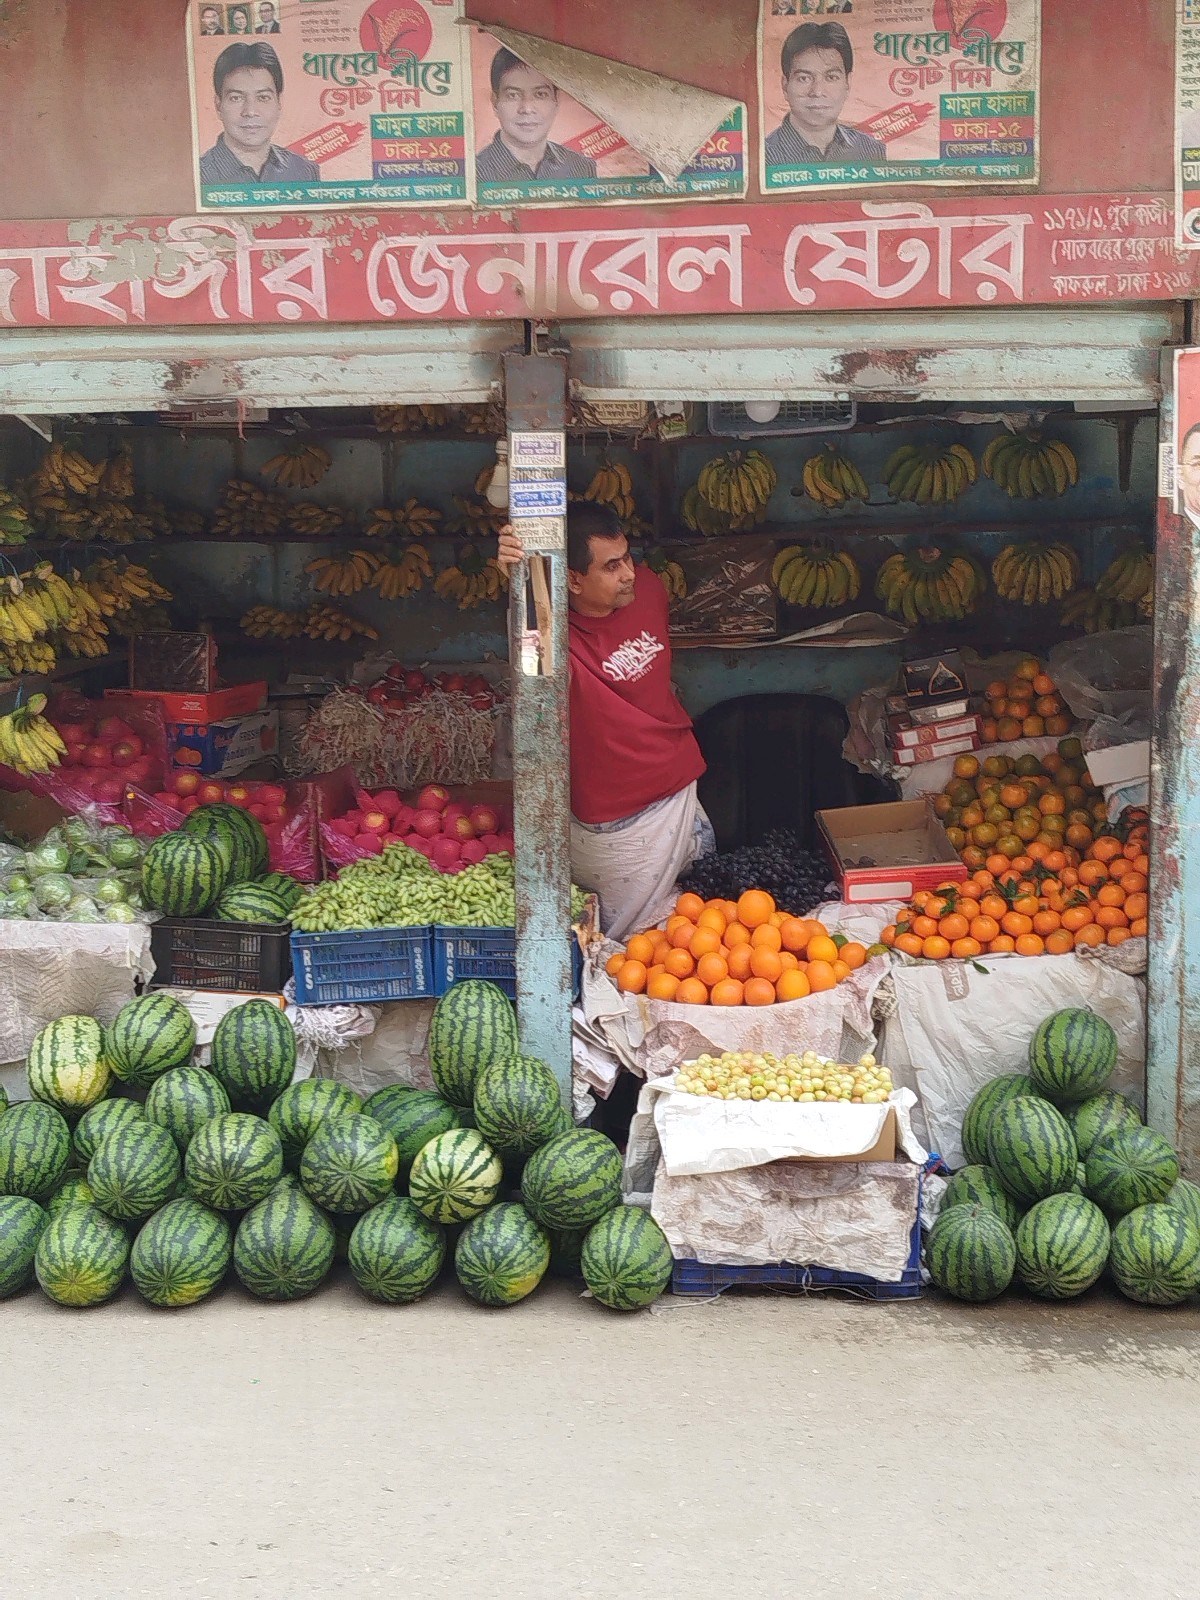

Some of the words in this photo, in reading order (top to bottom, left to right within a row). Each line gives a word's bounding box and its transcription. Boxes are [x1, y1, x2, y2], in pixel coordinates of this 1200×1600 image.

[873, 31, 950, 66] ধানের
[962, 28, 1026, 75] শীষে
[303, 52, 378, 86] ধানের
[390, 48, 454, 96] শীষে
[889, 58, 946, 97] ভোট
[948, 59, 995, 92] দিন
[320, 79, 376, 117] ভোট
[377, 79, 423, 112] দিন
[944, 96, 984, 117] মামুন
[984, 94, 1029, 115] হাসান
[374, 116, 414, 138] মামুন
[413, 114, 458, 134] হাসান
[872, 113, 919, 141] বাংলাদেশ
[951, 120, 1022, 140] ঢাকা-১৫
[305, 133, 350, 161] বাংলাদেশ
[382, 140, 453, 159] ঢাকা-১৫
[366, 223, 752, 316] জেনারেল
[784, 201, 1034, 305] ষ্টোর
